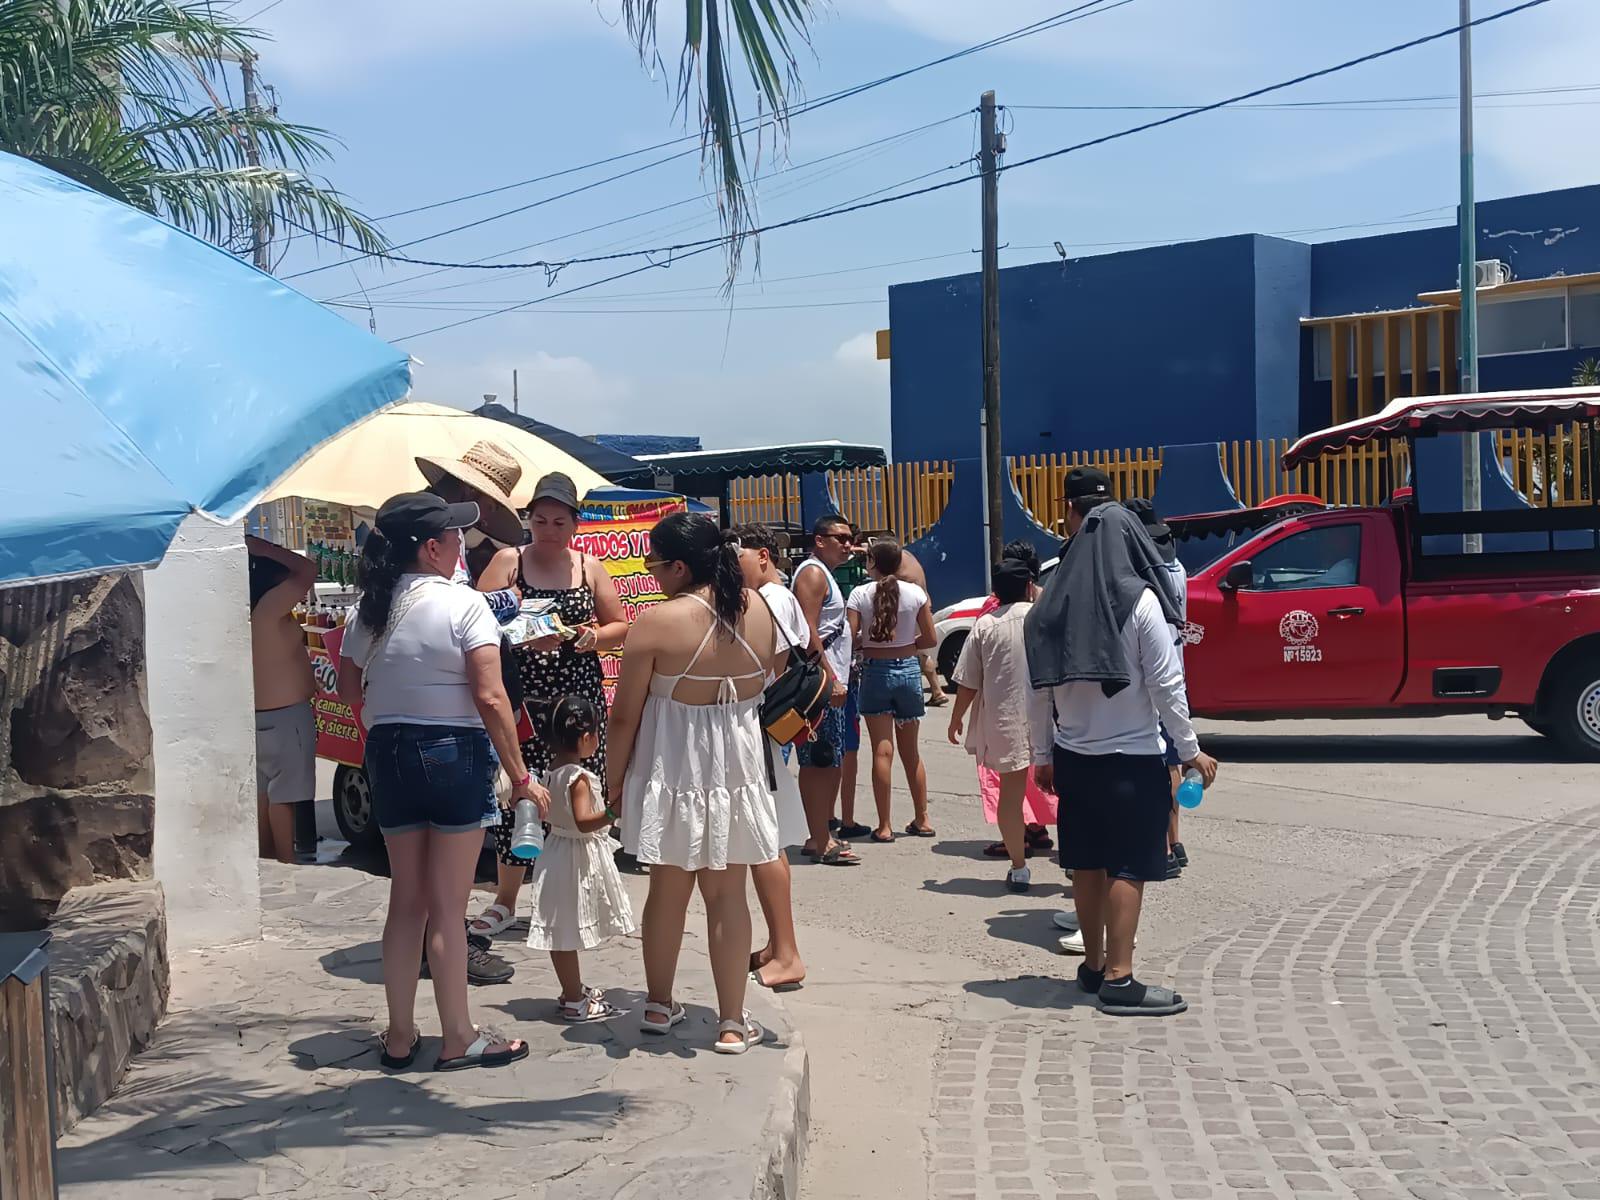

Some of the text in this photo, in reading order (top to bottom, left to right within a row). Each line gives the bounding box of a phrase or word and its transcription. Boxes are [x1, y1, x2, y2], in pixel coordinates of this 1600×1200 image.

[629, 531, 642, 557] Y
[317, 698, 354, 718] camaro
[327, 719, 359, 739] sierra
